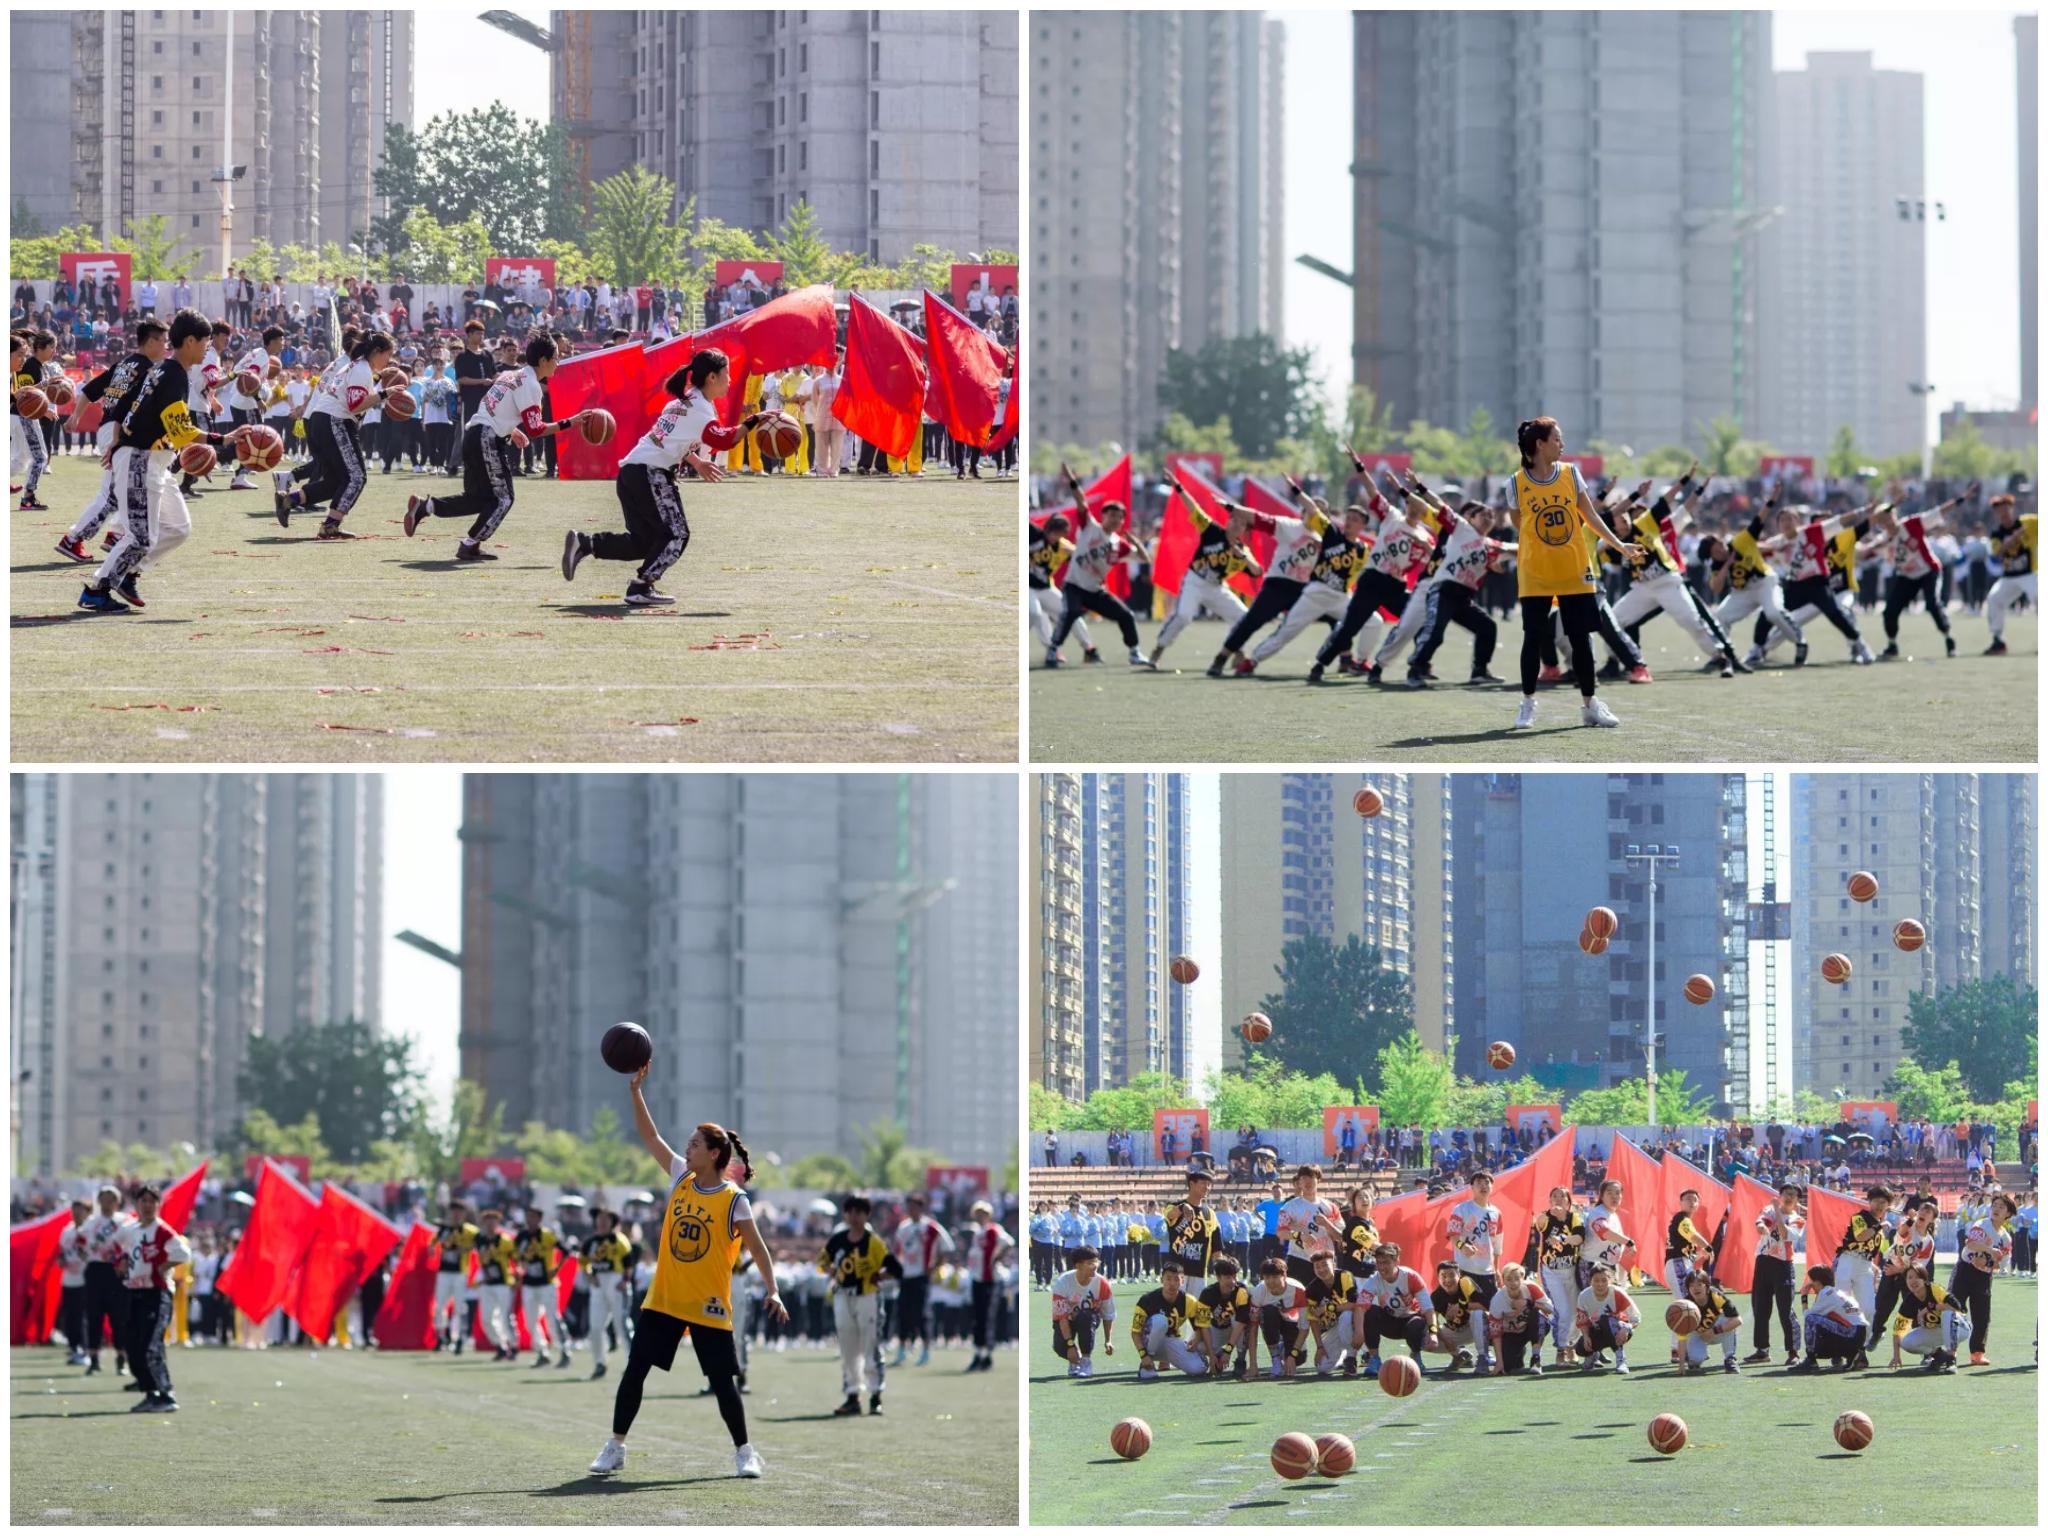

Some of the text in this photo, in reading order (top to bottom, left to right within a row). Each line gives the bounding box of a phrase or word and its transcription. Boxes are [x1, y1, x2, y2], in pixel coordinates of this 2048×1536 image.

[1531, 495, 1571, 513] CITY
[1543, 511, 1565, 527] 30
[1279, 543, 1317, 574] PT-BO
[673, 1204, 714, 1224] CITY
[678, 1221, 700, 1241] 30
